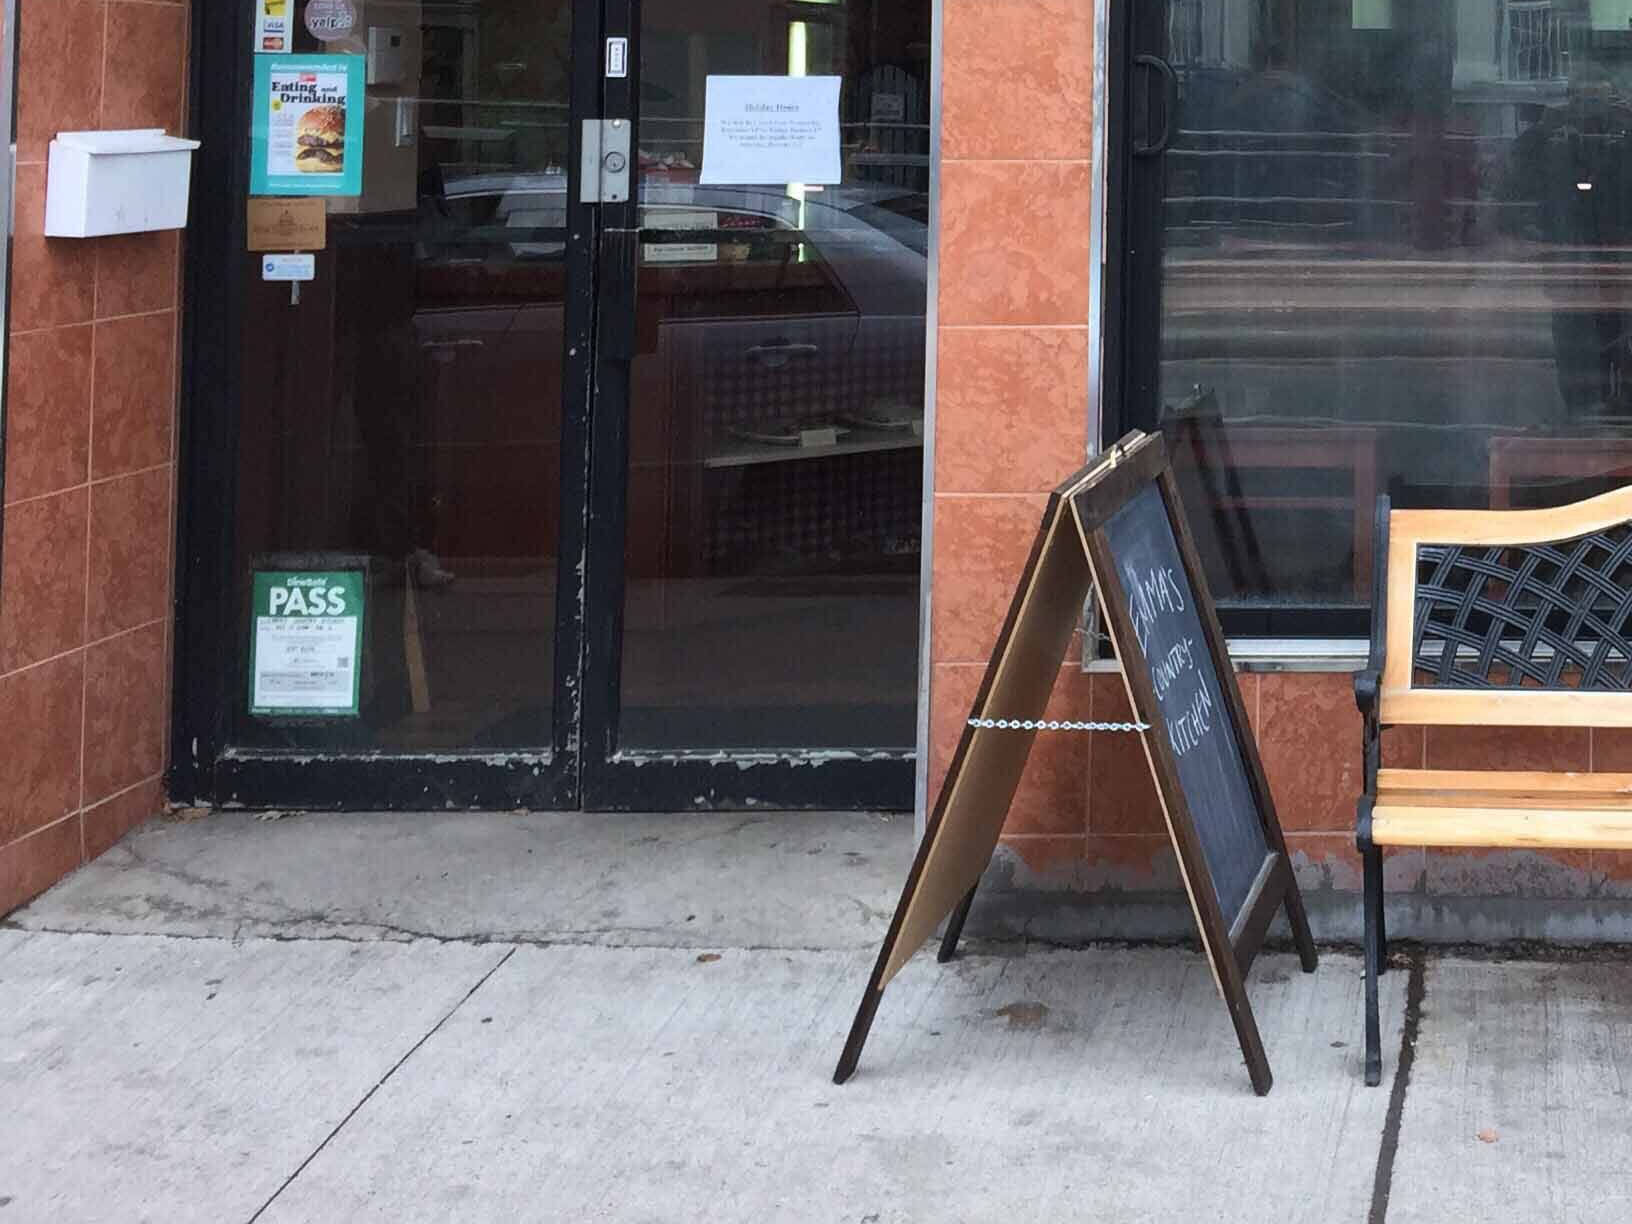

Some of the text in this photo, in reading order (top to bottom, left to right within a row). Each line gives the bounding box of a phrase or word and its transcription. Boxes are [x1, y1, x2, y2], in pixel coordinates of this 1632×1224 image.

[271, 82, 317, 94] Eating
[280, 93, 346, 105] Drinking
[269, 586, 346, 615] PASS
[1129, 567, 1184, 658] EMMA'S
[1167, 671, 1213, 756] KITCHEN
